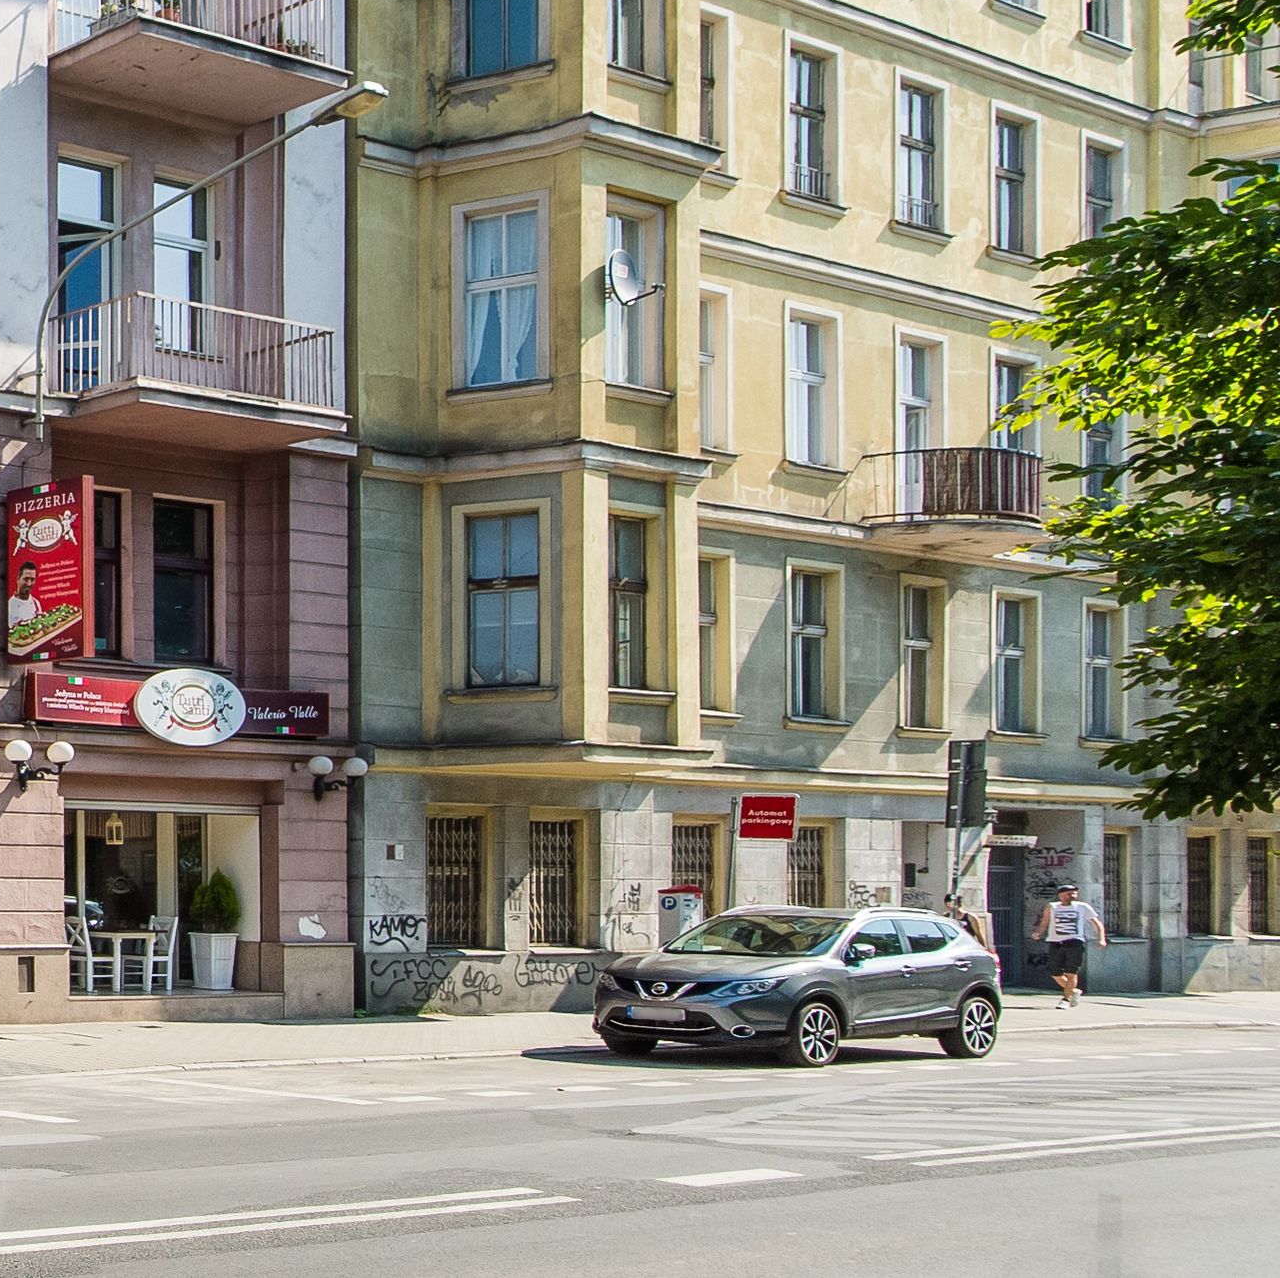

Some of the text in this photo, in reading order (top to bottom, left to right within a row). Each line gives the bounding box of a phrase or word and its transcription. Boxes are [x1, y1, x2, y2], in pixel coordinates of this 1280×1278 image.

[15, 492, 76, 514] PIZZERIA
[36, 529, 58, 542] Santi
[182, 704, 210, 716] Santi
[247, 705, 319, 720] Valerio Valle
[748, 809, 787, 817] Automat
[741, 817, 793, 826] parkingowy
